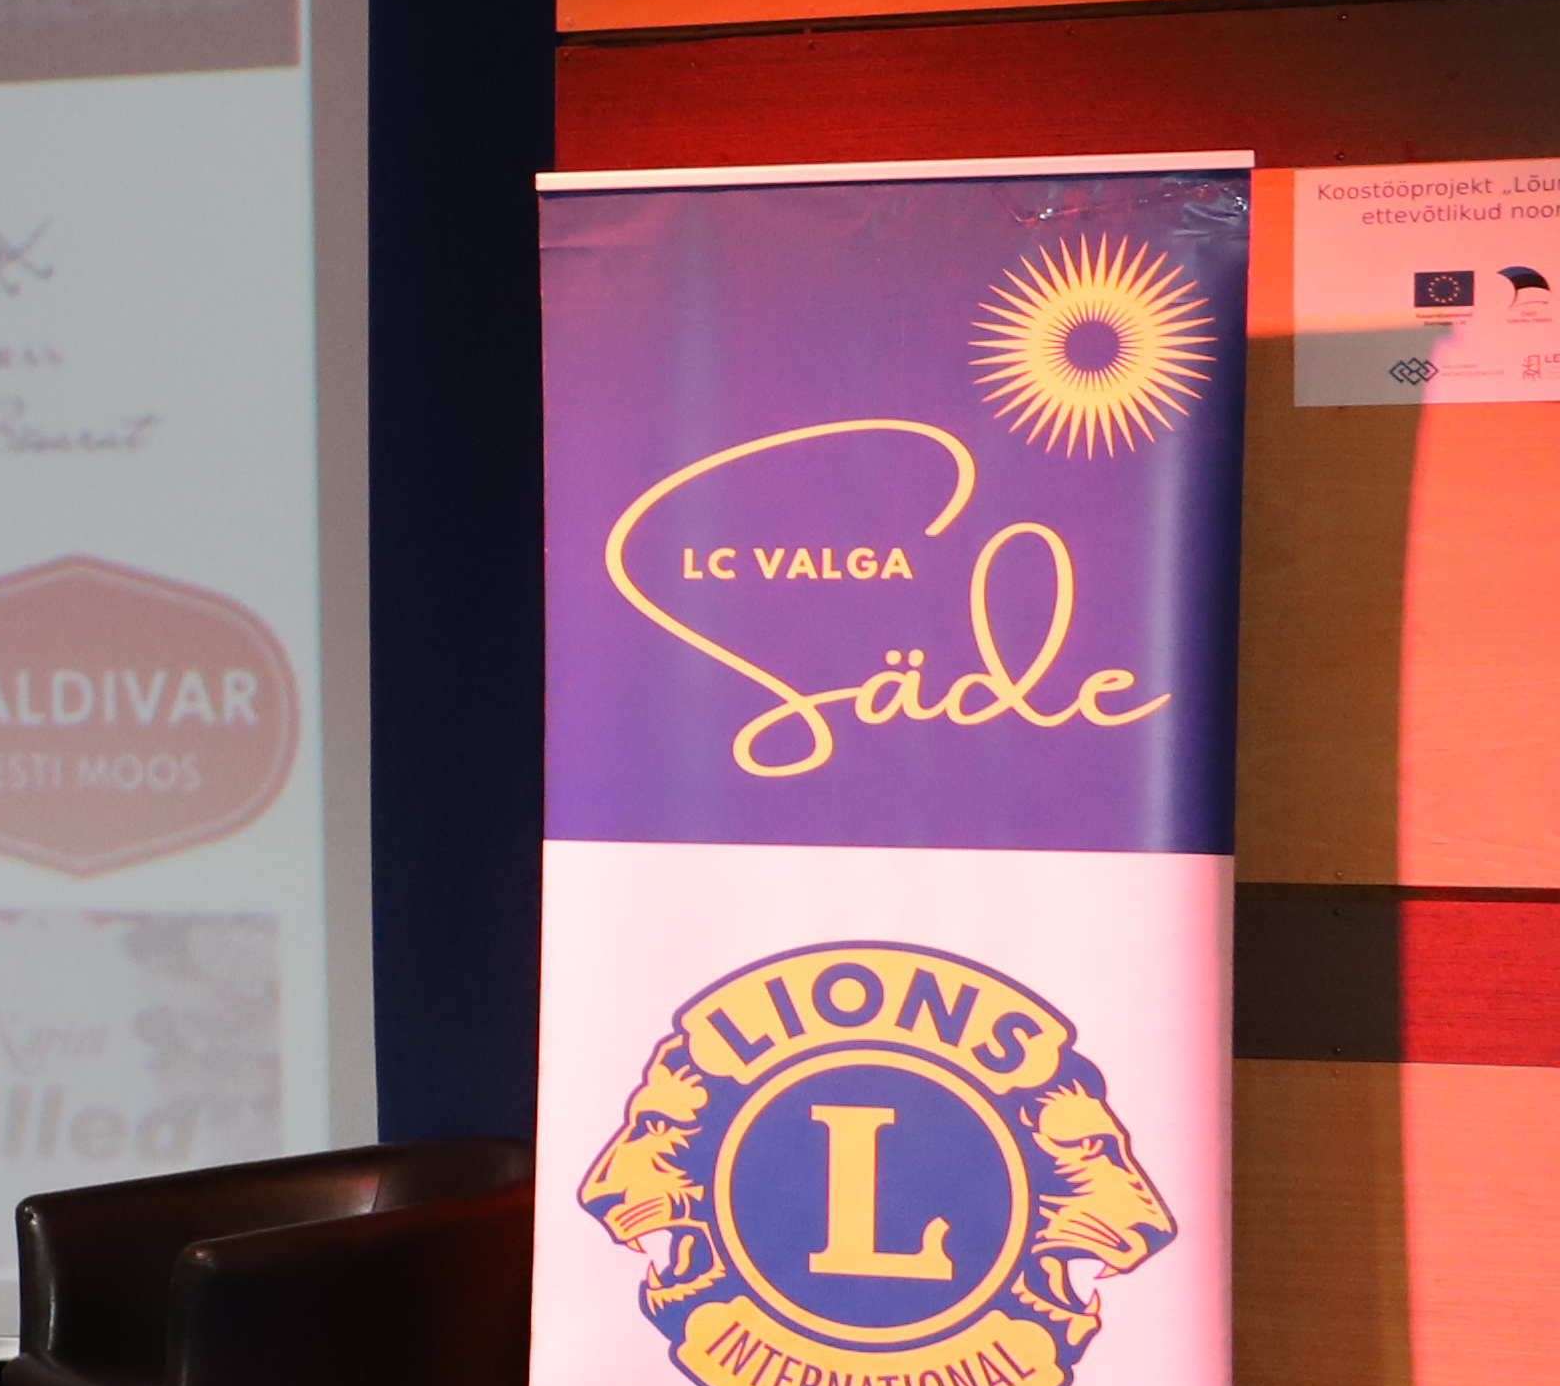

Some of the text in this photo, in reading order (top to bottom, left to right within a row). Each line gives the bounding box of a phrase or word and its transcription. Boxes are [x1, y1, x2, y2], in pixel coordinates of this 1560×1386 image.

[1317, 176, 1494, 201] Koostööprojekt
[1361, 203, 1502, 225] ettevõtlikud
[683, 546, 915, 581] LC VALGA
[605, 418, 1172, 778] Säde
[76, 750, 203, 794] MOOS
[705, 961, 1044, 1076] LIONS
[808, 1103, 954, 1282] L
